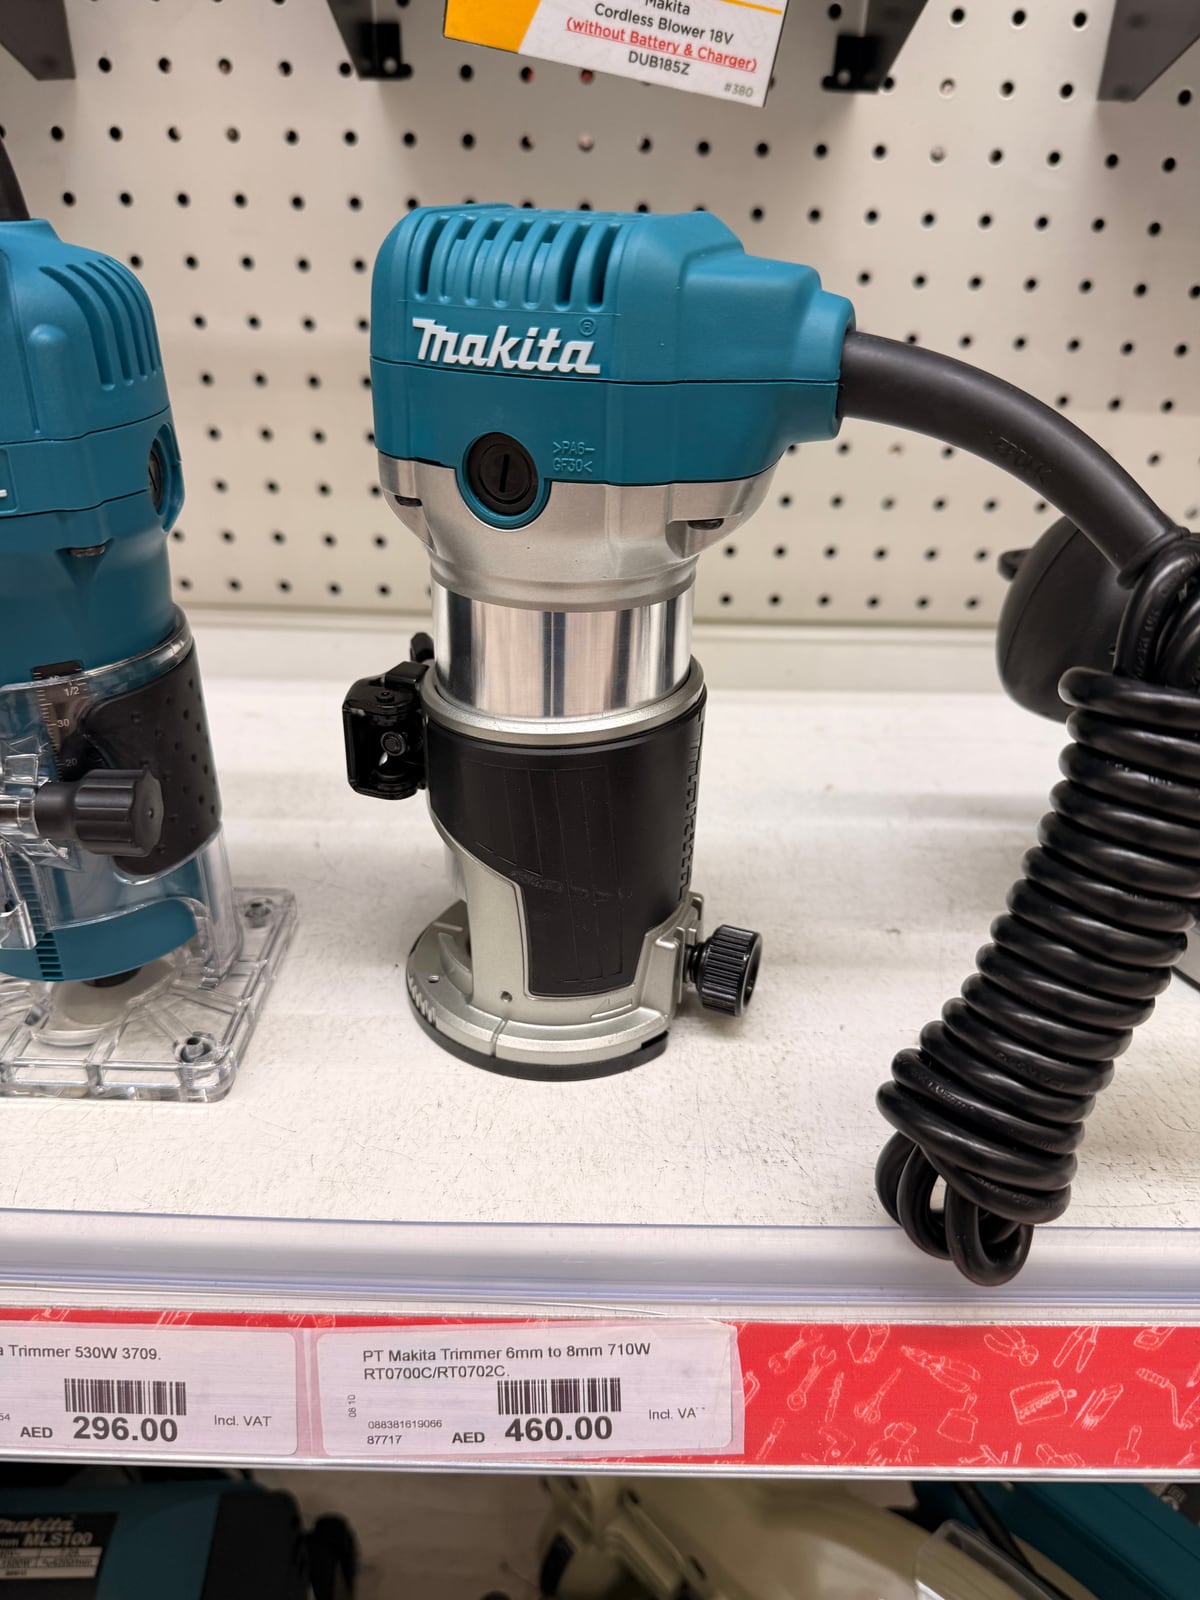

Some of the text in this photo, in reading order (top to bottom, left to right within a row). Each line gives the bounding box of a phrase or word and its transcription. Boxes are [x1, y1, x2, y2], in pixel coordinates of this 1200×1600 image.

[594, 4, 735, 45] Cordless Blower 18V
[566, 17, 757, 73] (without Battery & Charger)
[628, 51, 691, 76] DUB185Z
[724, 83, 754, 98] #380
[64, 686, 80, 697] 1/2
[57, 718, 70, 728] 30
[8, 1344, 71, 1357] Trimmer
[75, 1346, 118, 1359] 530W
[122, 1347, 162, 1361] 3709.
[363, 1343, 651, 1362] PT Makita Trimmer 6mm to 8mm 710W
[364, 1365, 510, 1380] RT0700C/RT0702C.
[20, 1415, 272, 1442] AED 296.00 Incl. VAT
[368, 1420, 442, 1430] 088381619066
[452, 1407, 705, 1444] AED 460.00 Incl. VA
[367, 1435, 402, 1445] 87717
[23, 1532, 93, 1546] MLS100
